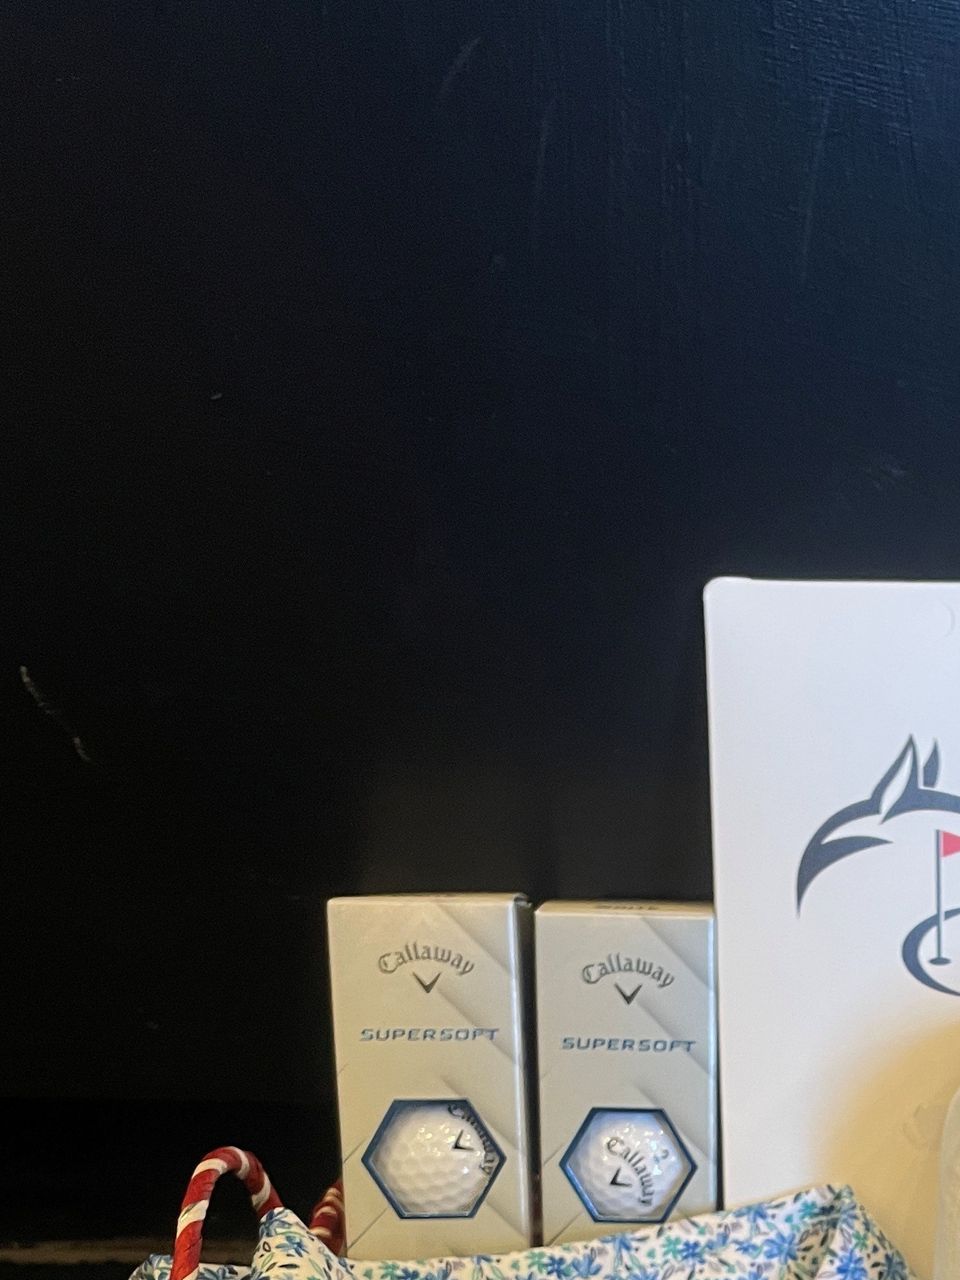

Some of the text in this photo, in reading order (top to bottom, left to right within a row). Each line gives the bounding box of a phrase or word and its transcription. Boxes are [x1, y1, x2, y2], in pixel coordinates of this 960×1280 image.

[378, 941, 475, 976] Callaway
[582, 953, 675, 988] Callaway
[359, 1027, 500, 1042] SUPERSOFT
[561, 1036, 696, 1053] SUPERSOFT
[606, 1136, 655, 1207] Callaway
